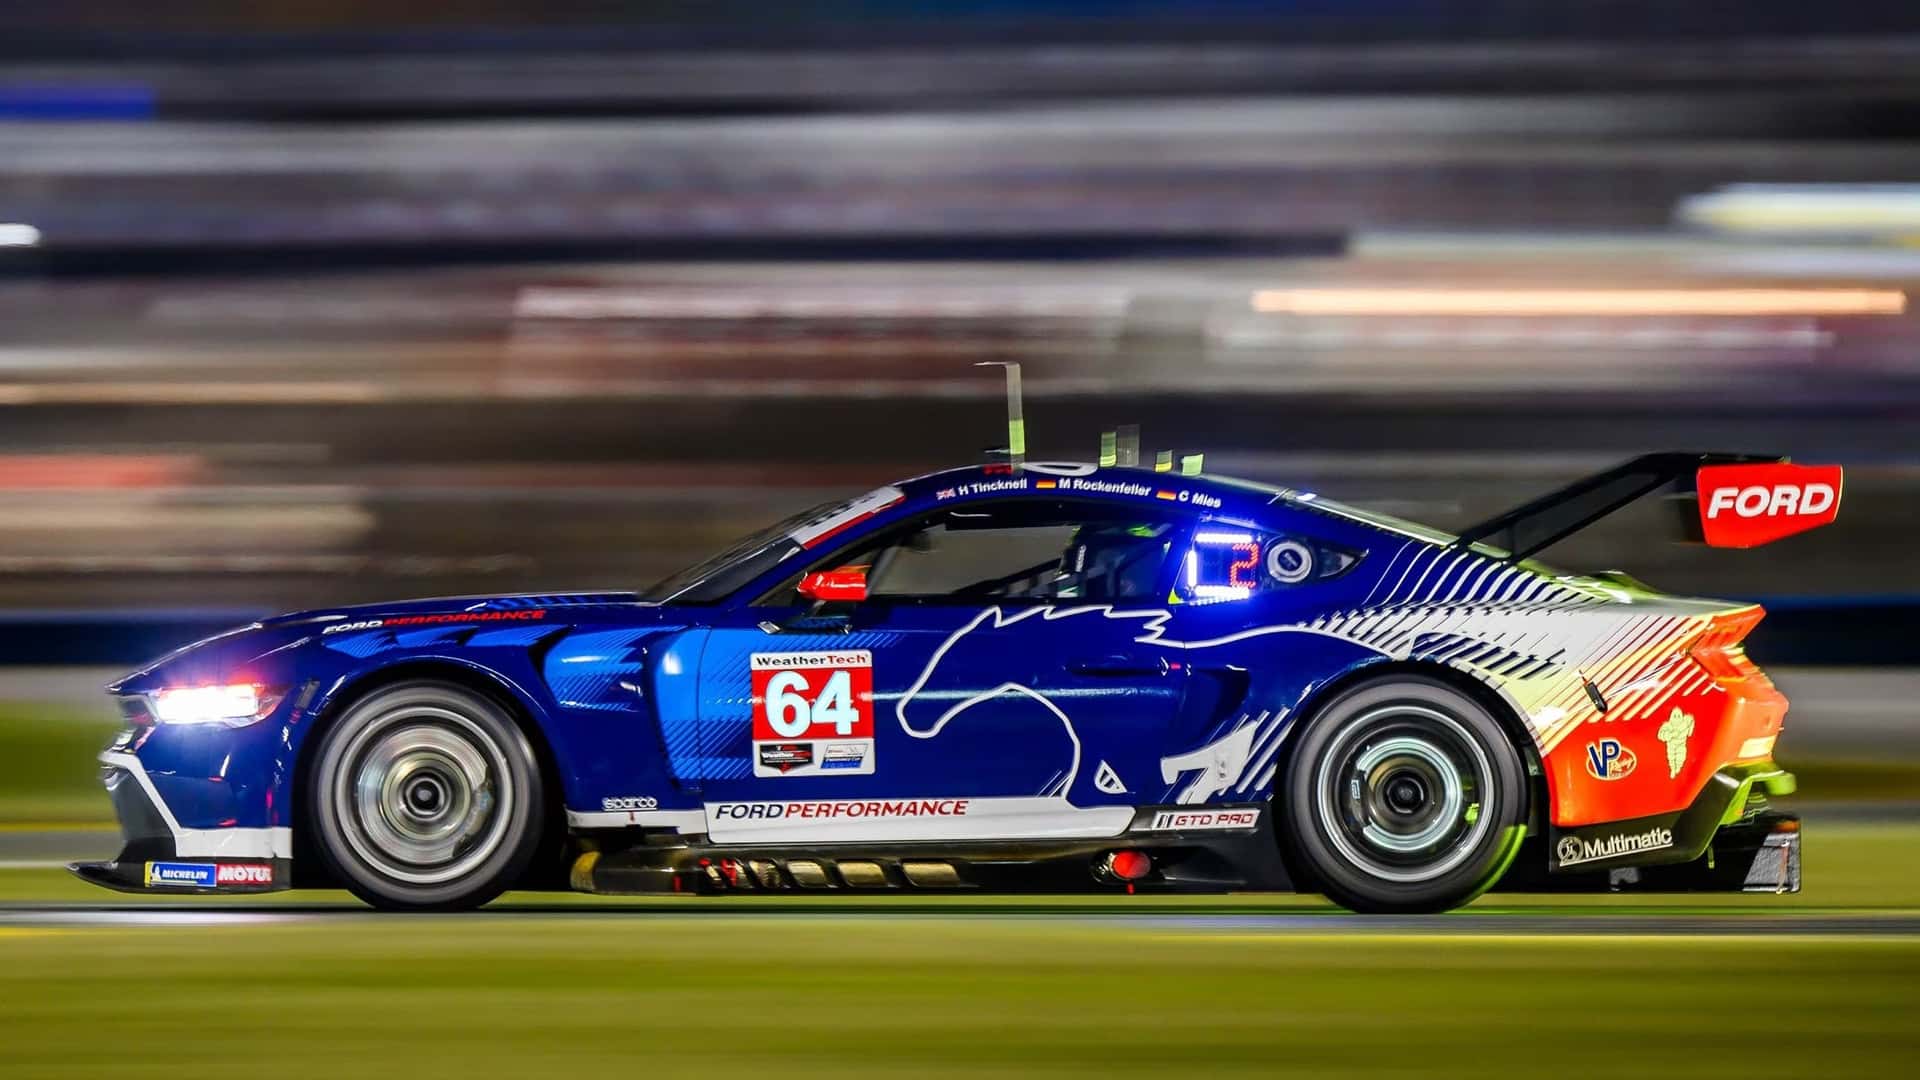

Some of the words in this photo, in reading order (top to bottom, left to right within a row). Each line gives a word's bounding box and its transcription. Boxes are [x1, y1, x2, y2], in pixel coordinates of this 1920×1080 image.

[958, 485, 969, 496] H
[970, 478, 1028, 494] Tincknell
[1058, 477, 1071, 489] M
[1191, 492, 1222, 508] Mies
[1707, 483, 1834, 519] FORD
[756, 655, 866, 667] WeatherTech
[765, 670, 859, 738] 64
[1587, 738, 1622, 779] VP
[602, 797, 657, 811] sparco
[1174, 814, 1213, 826] GTD
[1216, 813, 1254, 825] PRO
[1584, 827, 1673, 858] Multimatic
[161, 868, 208, 880] MICHELIN
